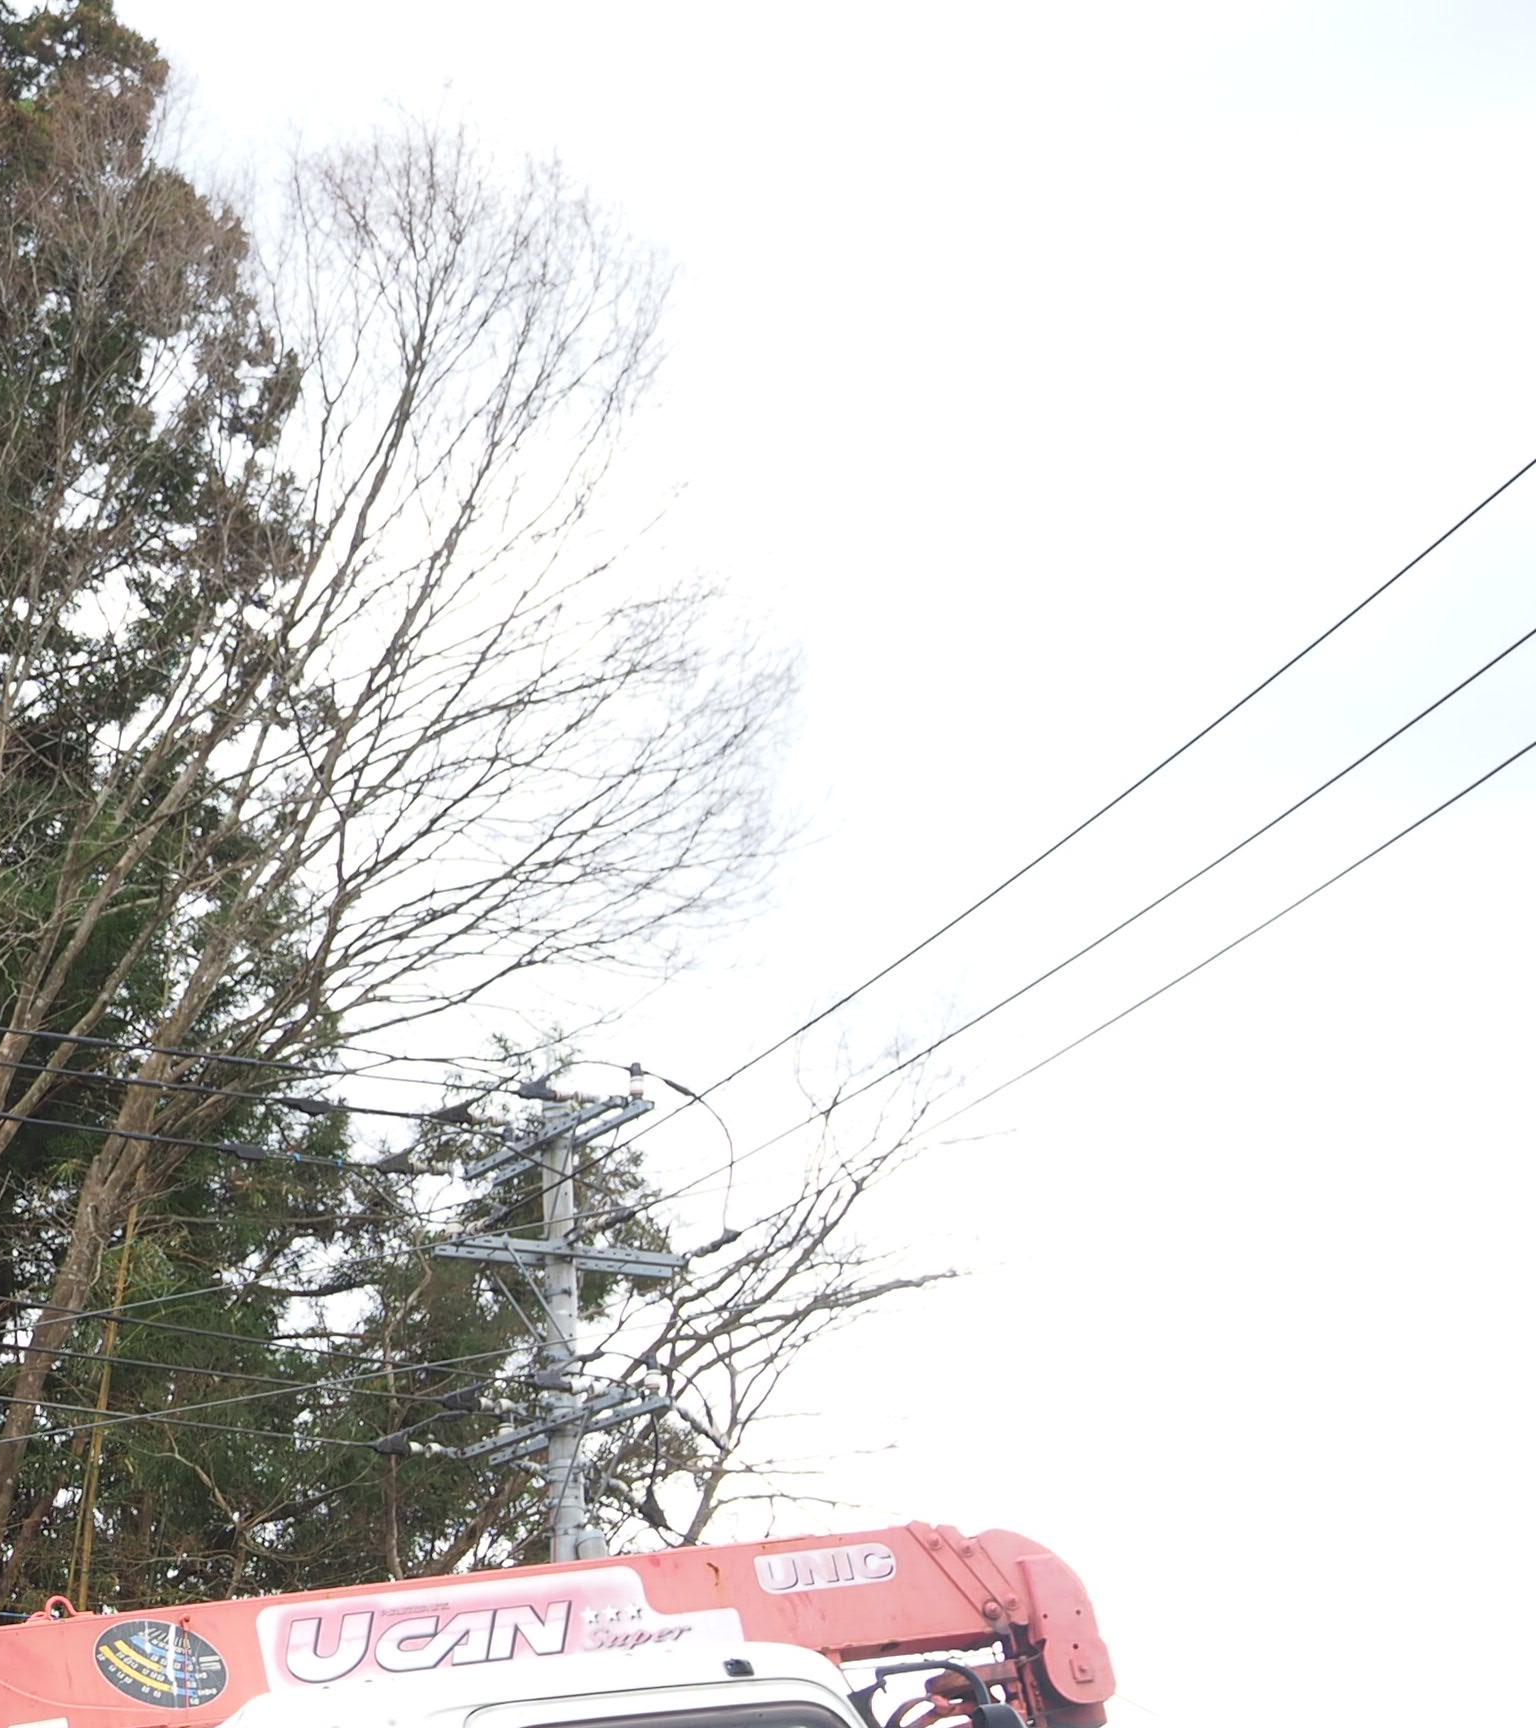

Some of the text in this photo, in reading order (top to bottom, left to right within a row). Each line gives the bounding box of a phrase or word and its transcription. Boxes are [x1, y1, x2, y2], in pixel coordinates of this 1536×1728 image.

[760, 1551, 894, 1591] UNIC
[286, 1600, 572, 1683] UCAN
[582, 1625, 692, 1651] Super
